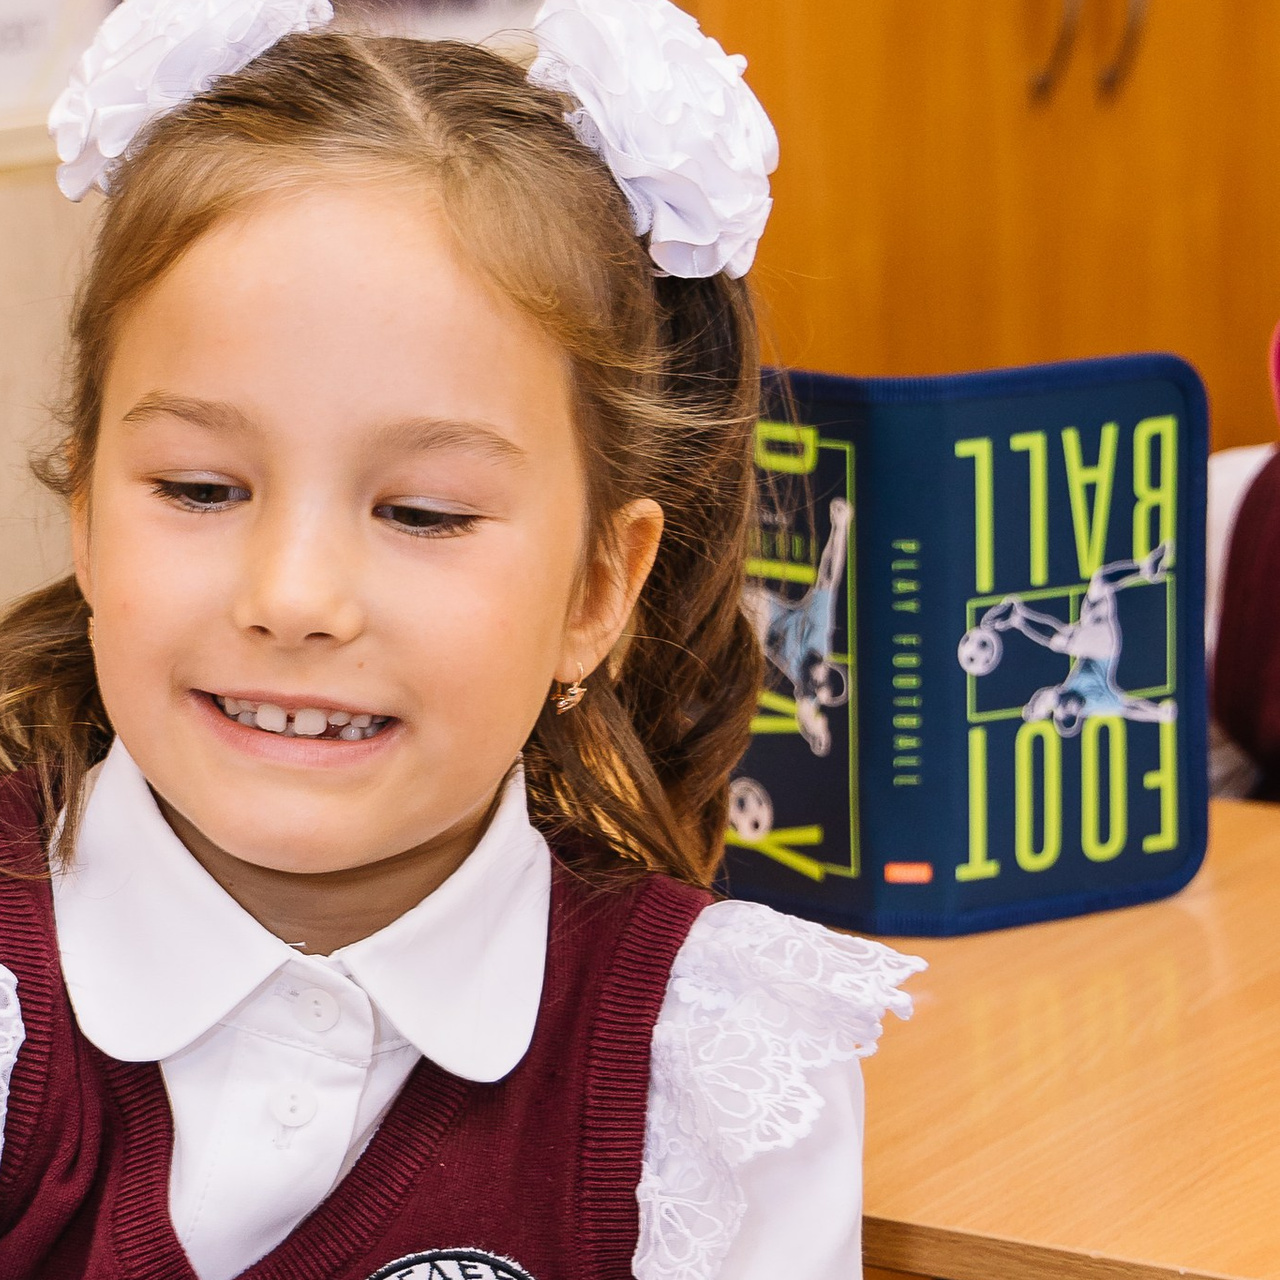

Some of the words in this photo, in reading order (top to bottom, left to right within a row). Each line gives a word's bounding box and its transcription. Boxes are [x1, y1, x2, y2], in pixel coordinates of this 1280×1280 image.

[891, 539, 921, 615] PLAY
[954, 415, 1178, 593] BALL
[892, 634, 922, 787] FOOTBALL
[955, 715, 1179, 882] FOOT
